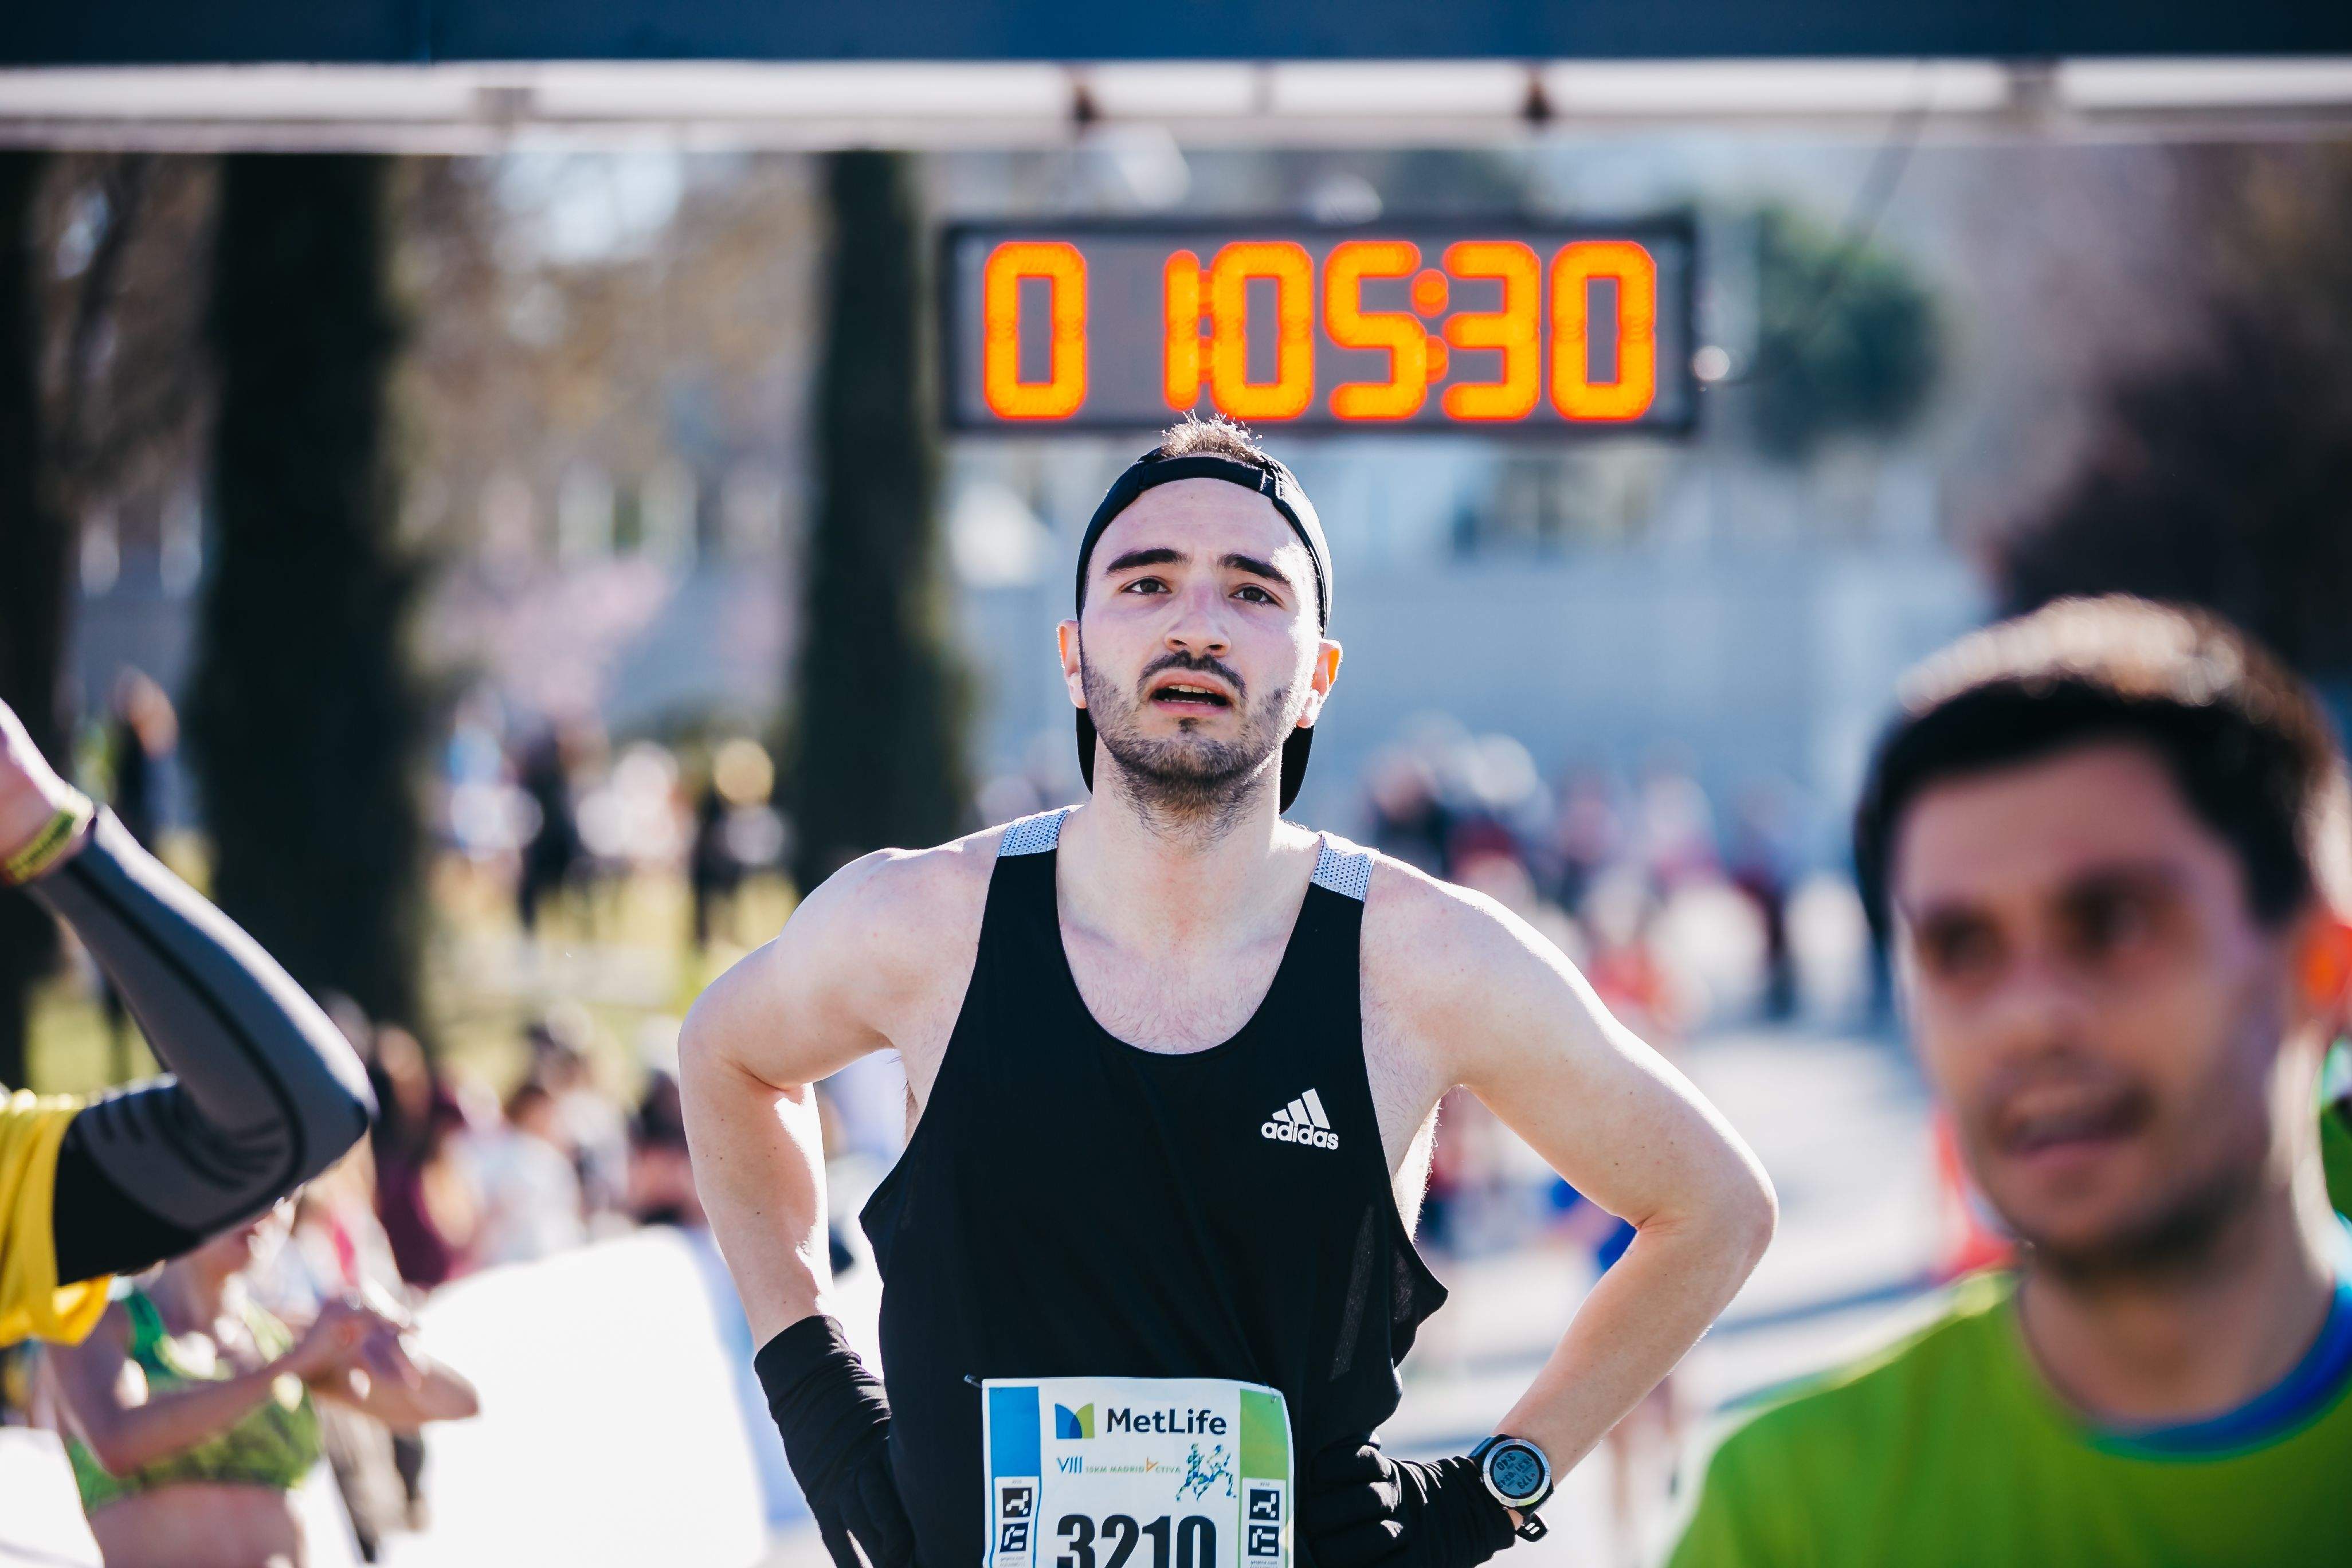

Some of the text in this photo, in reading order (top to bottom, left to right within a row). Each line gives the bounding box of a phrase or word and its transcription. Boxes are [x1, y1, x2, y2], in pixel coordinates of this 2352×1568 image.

[984, 241, 1657, 421] 01:05:30
[1261, 1121, 1339, 1150] adidas
[1107, 1408, 1226, 1435] MetLife
[1057, 1456, 1083, 1473] VIII
[1057, 1514, 1216, 1568] 3210
